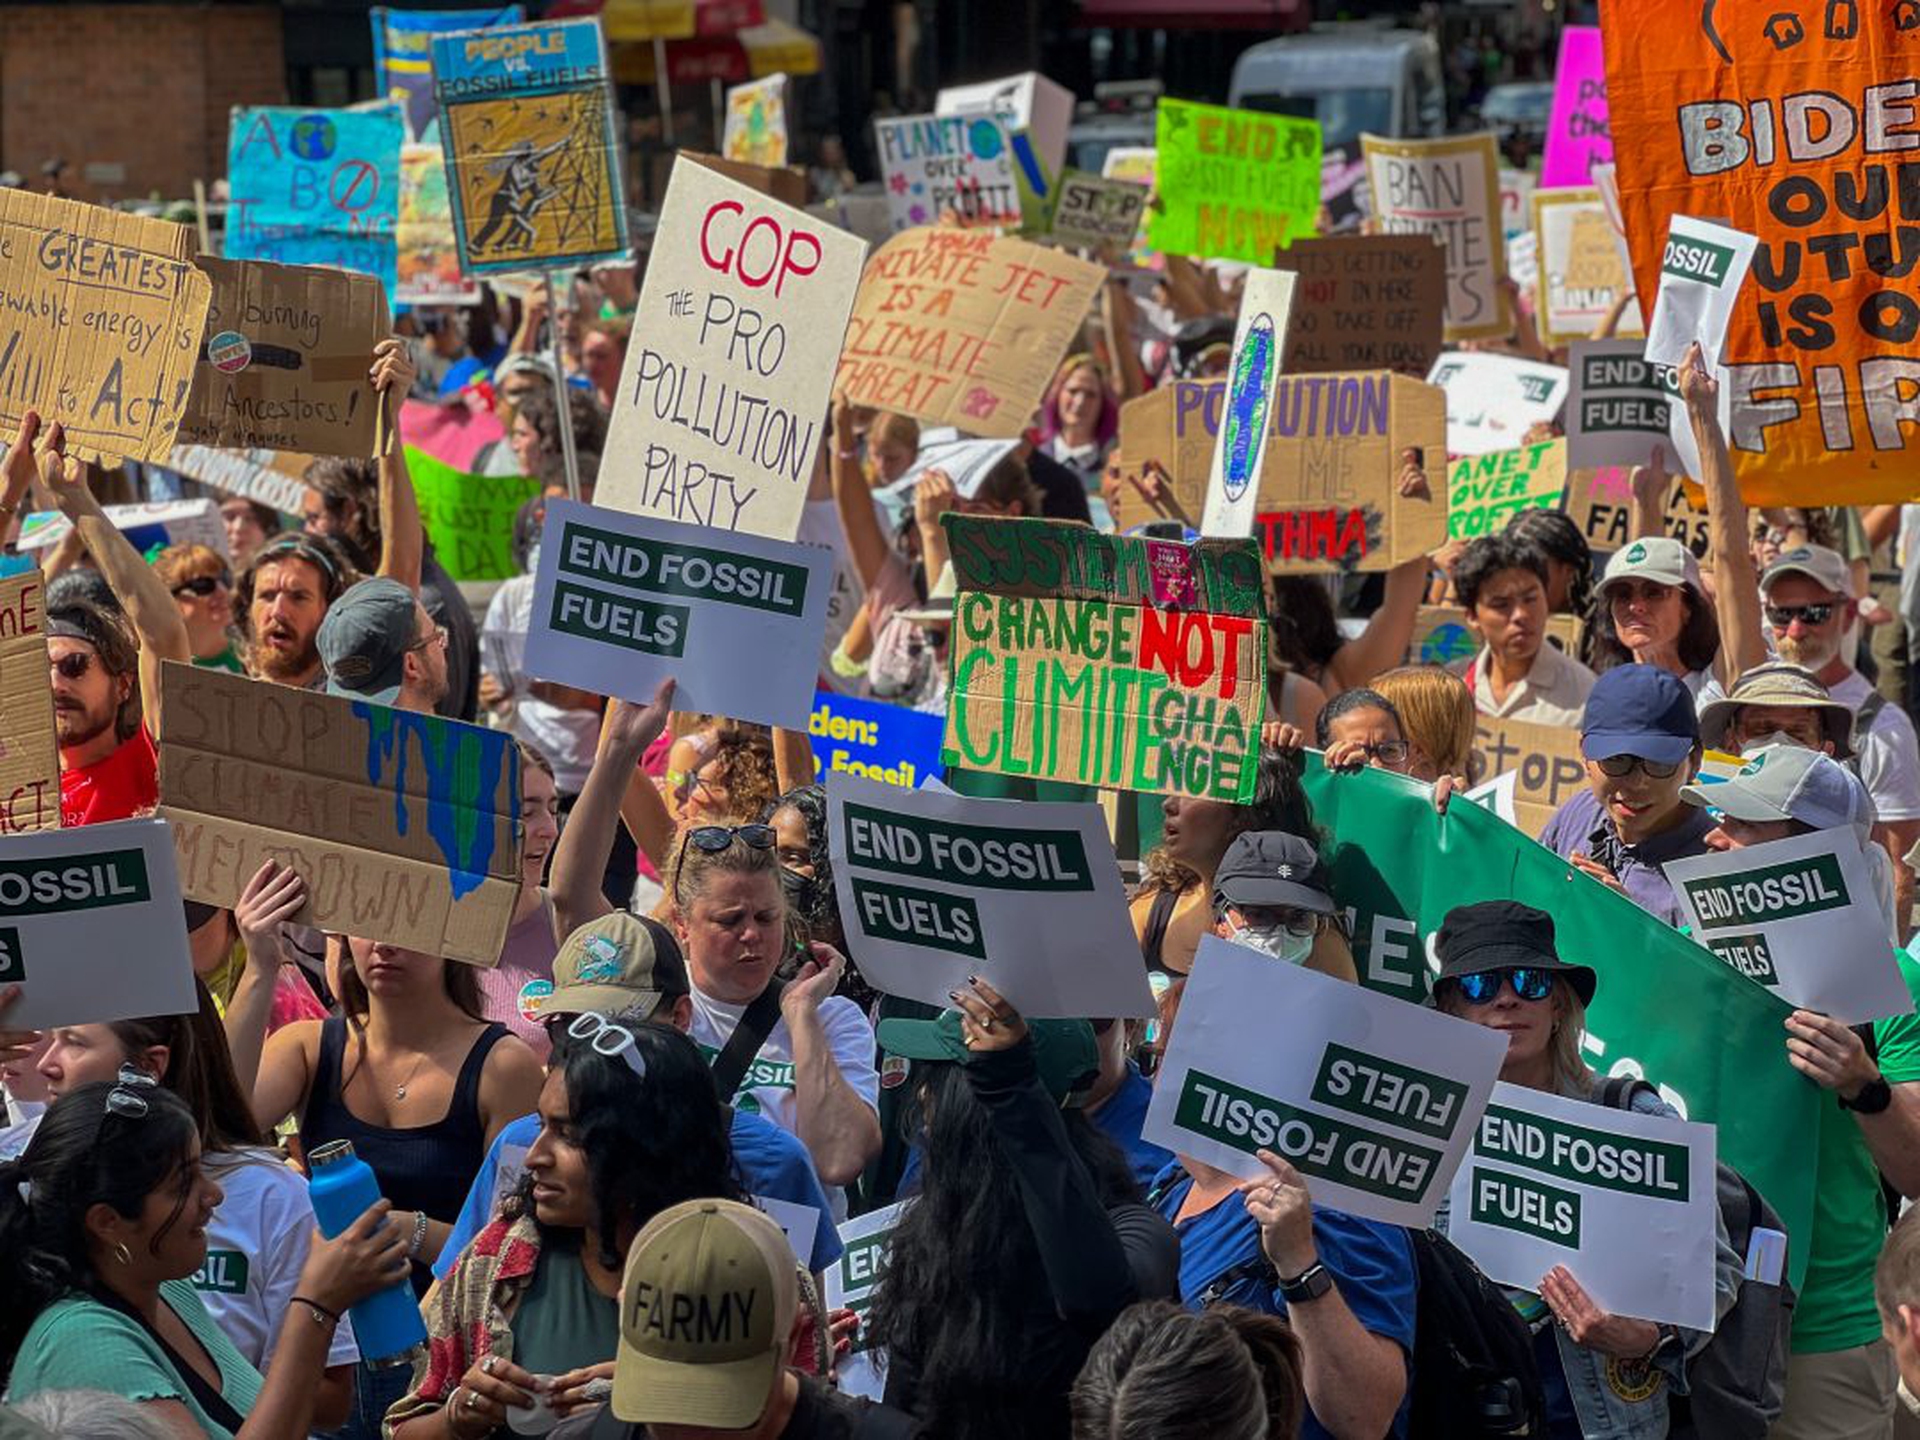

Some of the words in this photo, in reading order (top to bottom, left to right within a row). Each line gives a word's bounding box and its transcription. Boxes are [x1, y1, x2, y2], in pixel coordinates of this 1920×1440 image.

[465, 31, 567, 61] PEOPLE
[438, 73, 520, 98] FOSSIL
[526, 65, 600, 86] FUELS
[881, 118, 965, 163] PLANET
[1196, 116, 1278, 162] END
[1679, 79, 1920, 176] BIDE
[1387, 160, 1465, 208] BAN
[38, 228, 190, 298] GREATEST
[700, 199, 822, 298] GOP
[924, 232, 997, 255] YOUR
[877, 284, 925, 313] IS
[922, 288, 956, 318] A
[993, 263, 1073, 311] JET
[1303, 280, 1339, 304] HOT
[0, 290, 69, 331] wable
[82, 309, 162, 356] energy
[176, 316, 193, 350] is
[245, 290, 322, 349] burning
[665, 288, 695, 317] THE
[699, 293, 786, 377] PRO
[1758, 293, 1836, 350] IS
[56, 374, 77, 413] to
[839, 358, 951, 413] THREAT
[1588, 361, 1646, 385] END
[223, 384, 359, 427] Ancestors!
[633, 349, 815, 482] POLLUTION
[1175, 374, 1391, 438] POUTION
[1585, 403, 1668, 428] FUELS
[641, 443, 758, 531] PARTY
[1306, 438, 1360, 502] ME
[1452, 472, 1531, 507] OVER
[568, 534, 650, 579] END
[657, 553, 794, 606] FOSSIL
[559, 592, 679, 647] FUELS
[962, 592, 1138, 664] CHANGE
[1139, 597, 1253, 701] NOT
[175, 683, 330, 771] STOP
[179, 754, 376, 839] CLIMATE
[173, 820, 431, 935] MELOWN
[850, 817, 923, 866] END
[929, 833, 1080, 882] FOSSIL
[0, 863, 136, 907] OSSIL
[1692, 886, 1734, 922] END
[1734, 868, 1839, 918] FOSSIL
[861, 891, 976, 945] FUELS
[1326, 1059, 1457, 1127] FUELS
[1194, 1083, 1340, 1166] FOSSIL
[1343, 1139, 1431, 1191] END
[1481, 1116, 1547, 1160] END
[1552, 1132, 1680, 1191] FOSSIL
[1478, 1179, 1574, 1236] FUELS
[631, 1281, 756, 1344] FARMY
